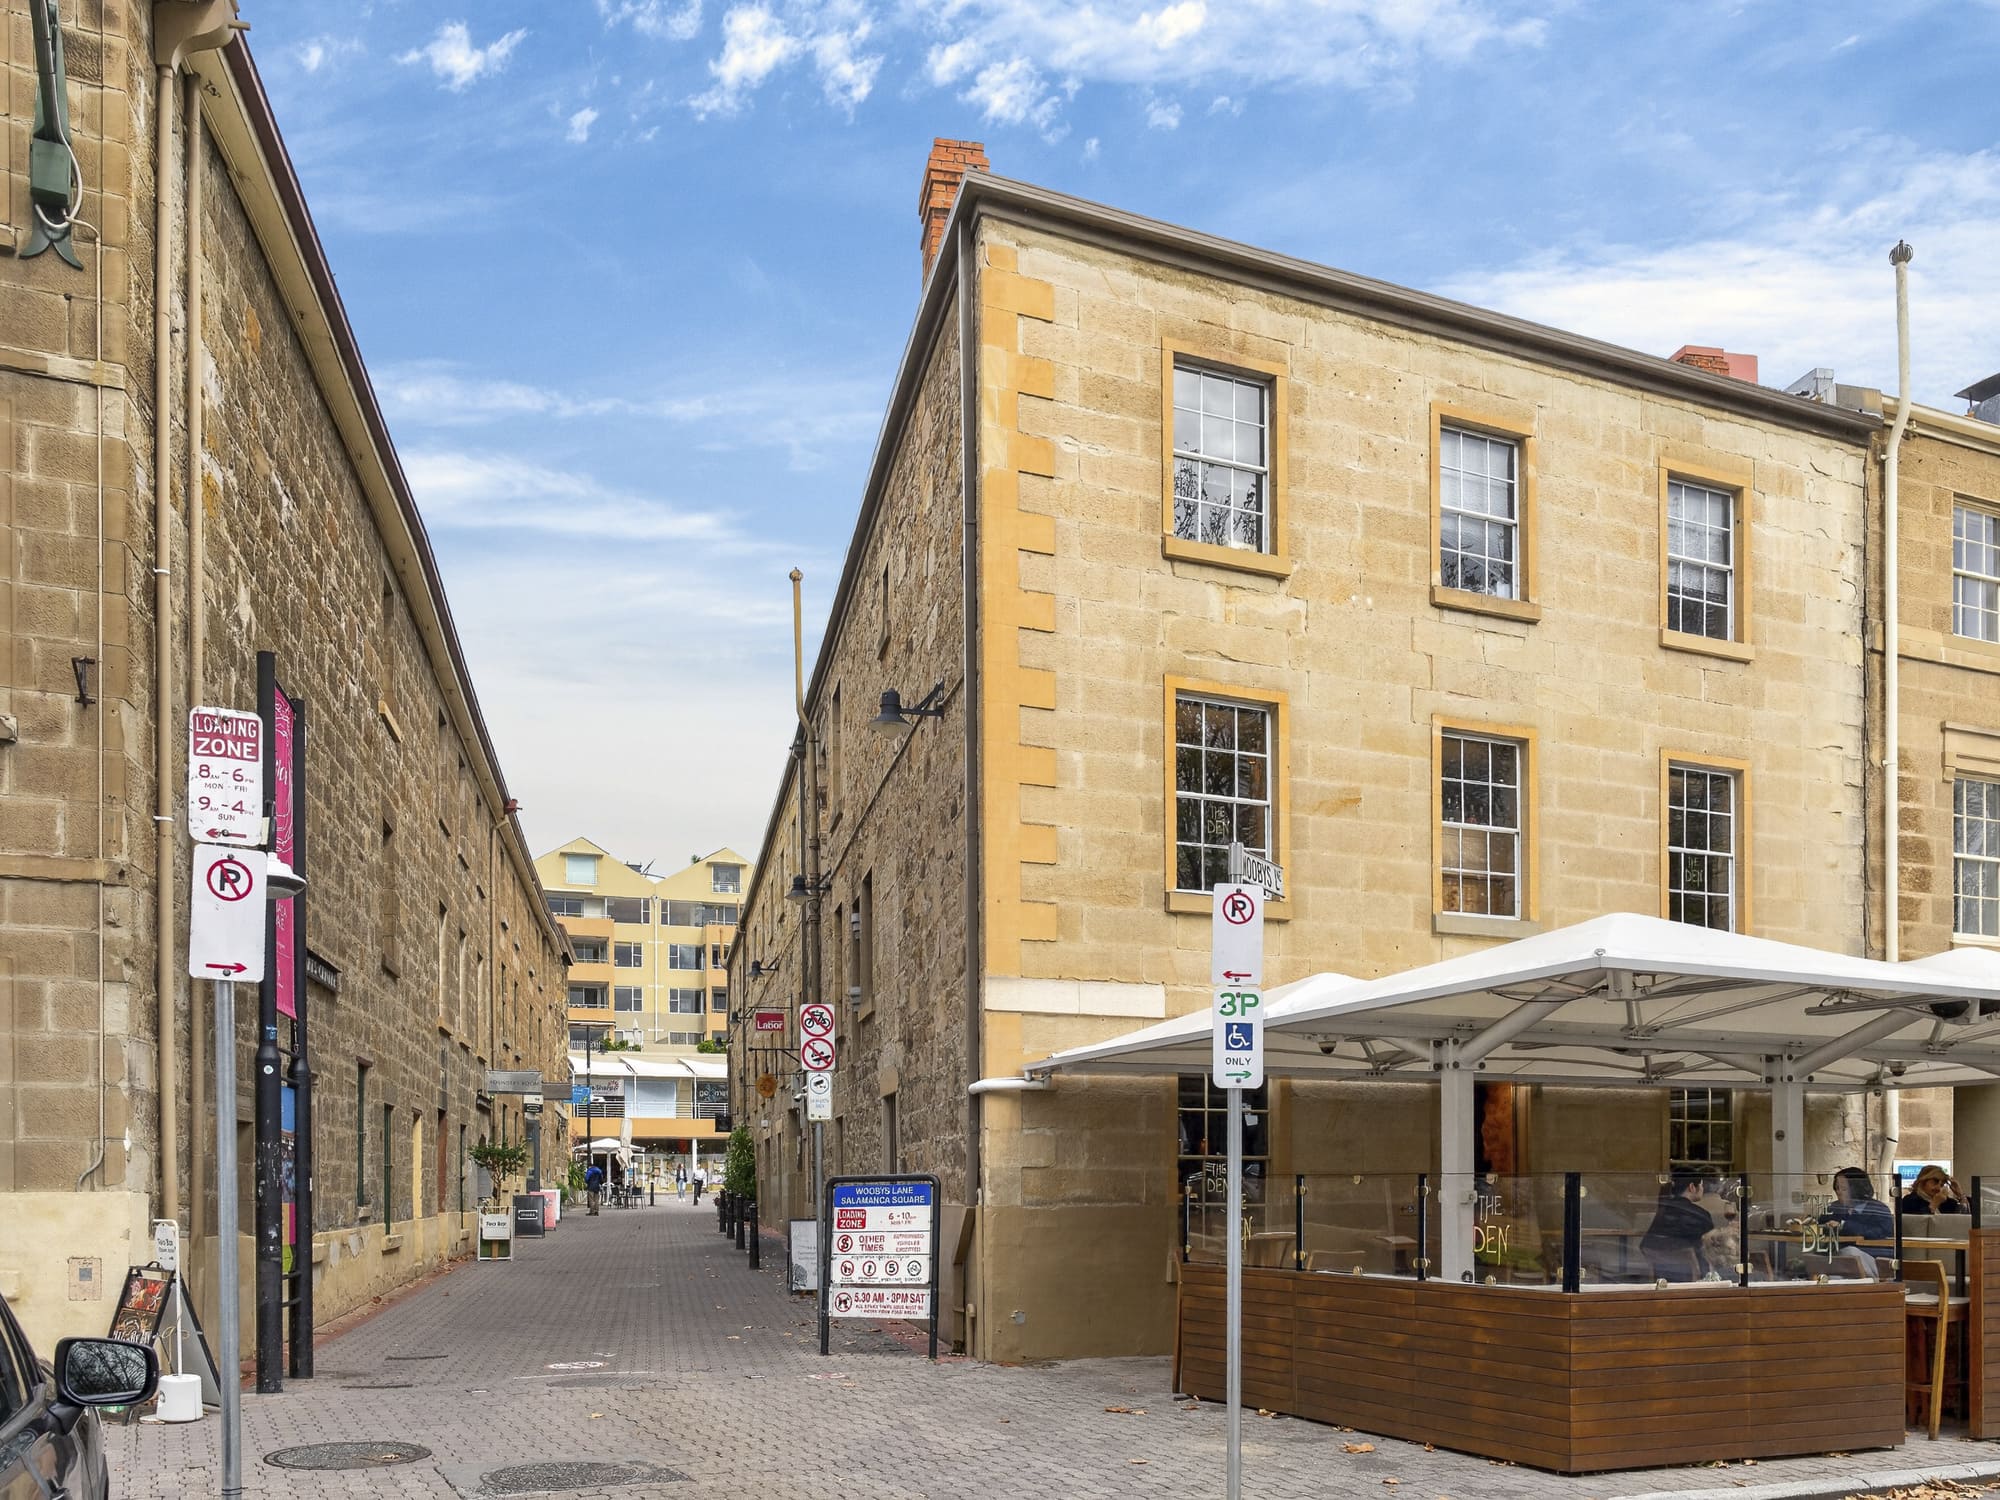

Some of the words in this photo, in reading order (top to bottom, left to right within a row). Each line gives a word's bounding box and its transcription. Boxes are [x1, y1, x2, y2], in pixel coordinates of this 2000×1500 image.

[195, 715, 258, 739] LOADING
[195, 737, 257, 760] ZONE
[204, 782, 224, 790] MON
[234, 785, 248, 793] FRI
[217, 813, 236, 821] SUN
[1209, 805, 1226, 820] THE
[1207, 820, 1230, 841] DEN
[1219, 992, 1260, 1017] 3P
[757, 1021, 783, 1030] Labor
[1225, 1057, 1252, 1066] ONLY
[892, 1186, 914, 1195] LANE
[1207, 1178, 1228, 1199] DEN
[841, 1197, 890, 1205] SALAMANCA
[891, 1196, 925, 1204] SQUARE
[837, 1209, 866, 1219] LOADING
[1478, 1195, 1503, 1224] THE
[1807, 1195, 1834, 1222] THE
[840, 1219, 863, 1228] ZONE
[859, 1235, 885, 1244] OTHER
[1472, 1224, 1511, 1266] DEN
[1801, 1225, 1840, 1265] DEN
[860, 1244, 885, 1252] TIMES
[854, 1292, 871, 1303] 5.30
[872, 1292, 885, 1303] AM
[891, 1293, 909, 1304] 3PM
[910, 1293, 926, 1304] SAT
